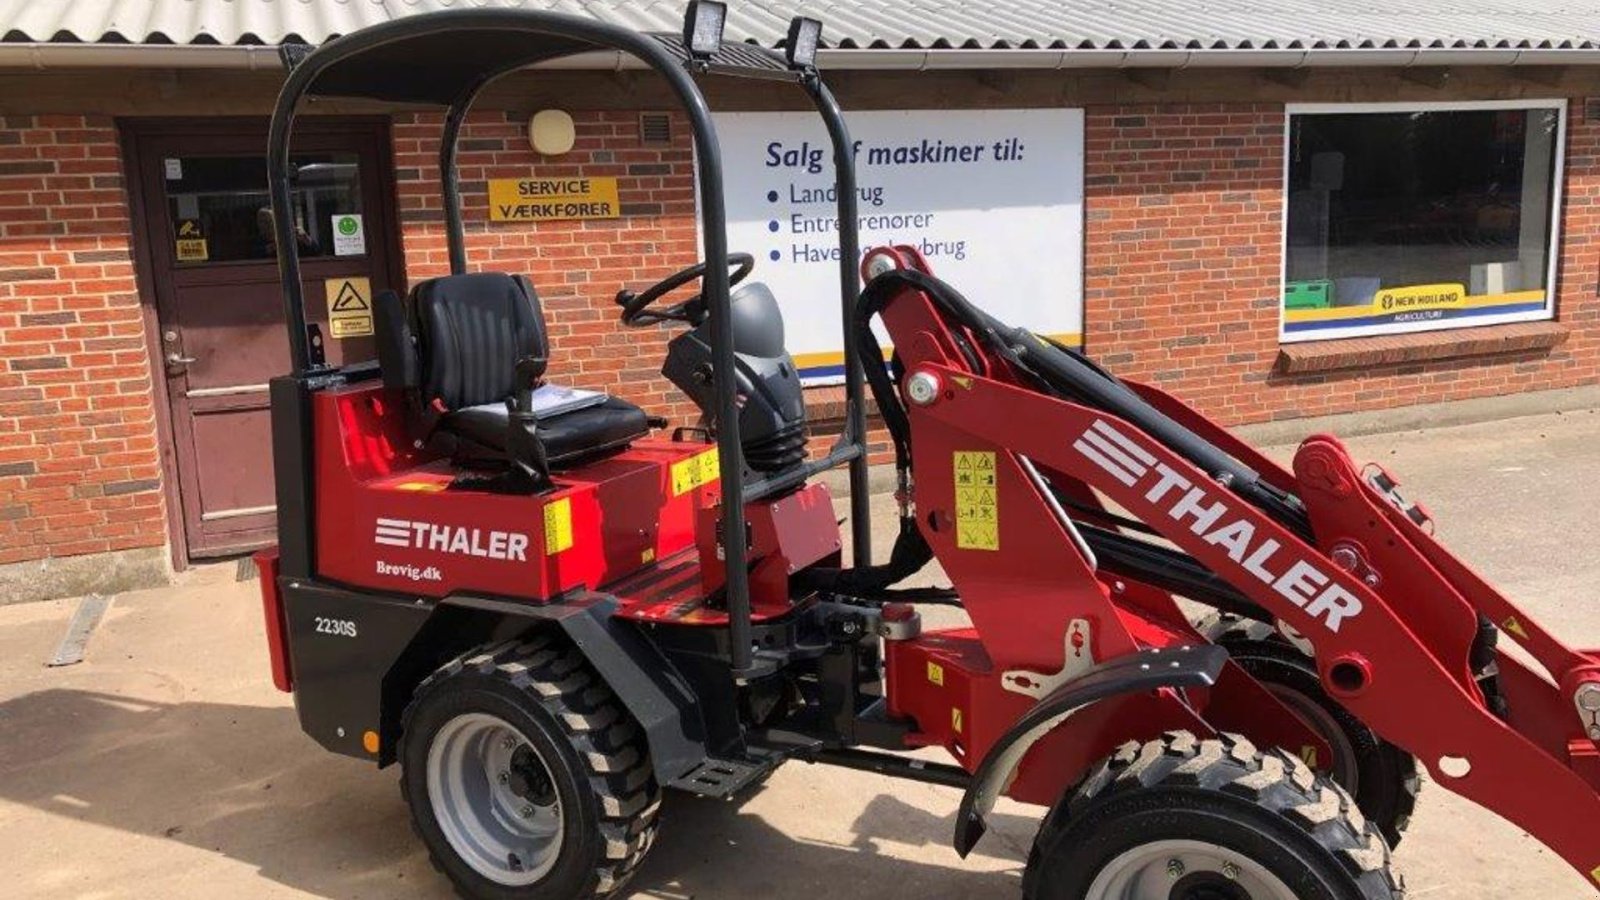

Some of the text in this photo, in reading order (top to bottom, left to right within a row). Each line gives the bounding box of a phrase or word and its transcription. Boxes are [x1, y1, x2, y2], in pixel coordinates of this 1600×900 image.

[765, 141, 824, 174] Salg
[867, 139, 984, 166] maskiner
[993, 137, 1025, 162] til:
[518, 180, 591, 195] SERVICE
[789, 182, 884, 206] Landug
[499, 202, 611, 218] VÆRKFØRER
[790, 213, 934, 234] Entrerenører
[1395, 292, 1459, 307] NEW HOLLAND
[1393, 309, 1443, 322] AGRICULTURE
[411, 521, 529, 562] THALER
[1144, 462, 1363, 634] THALER
[376, 560, 442, 581] Brovig.dk
[314, 616, 357, 638] 2230S
